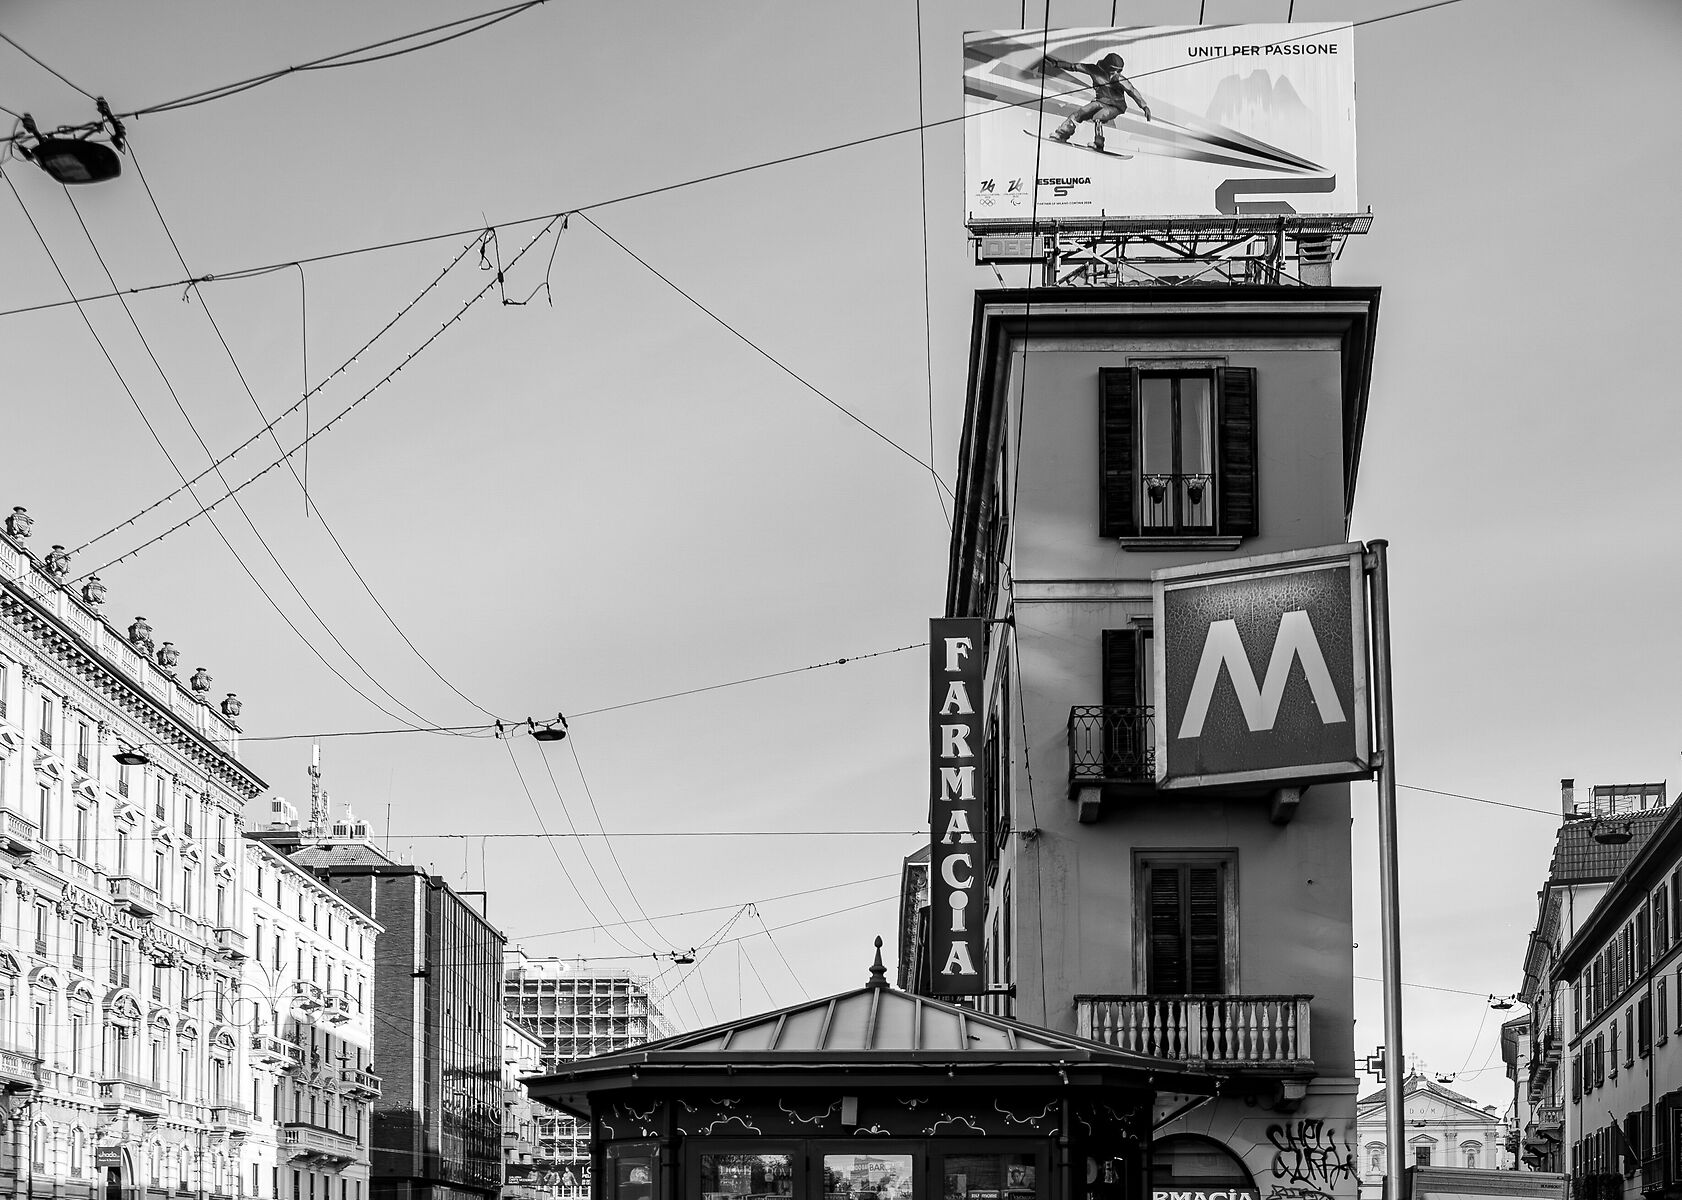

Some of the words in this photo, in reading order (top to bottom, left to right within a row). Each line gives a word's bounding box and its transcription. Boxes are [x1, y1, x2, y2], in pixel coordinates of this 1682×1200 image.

[1188, 46, 1229, 58] UNITI
[1232, 45, 1261, 56] PER
[1264, 43, 1338, 56] PASSIONE
[1177, 609, 1347, 740] M
[939, 636, 978, 977] FARMACIA
